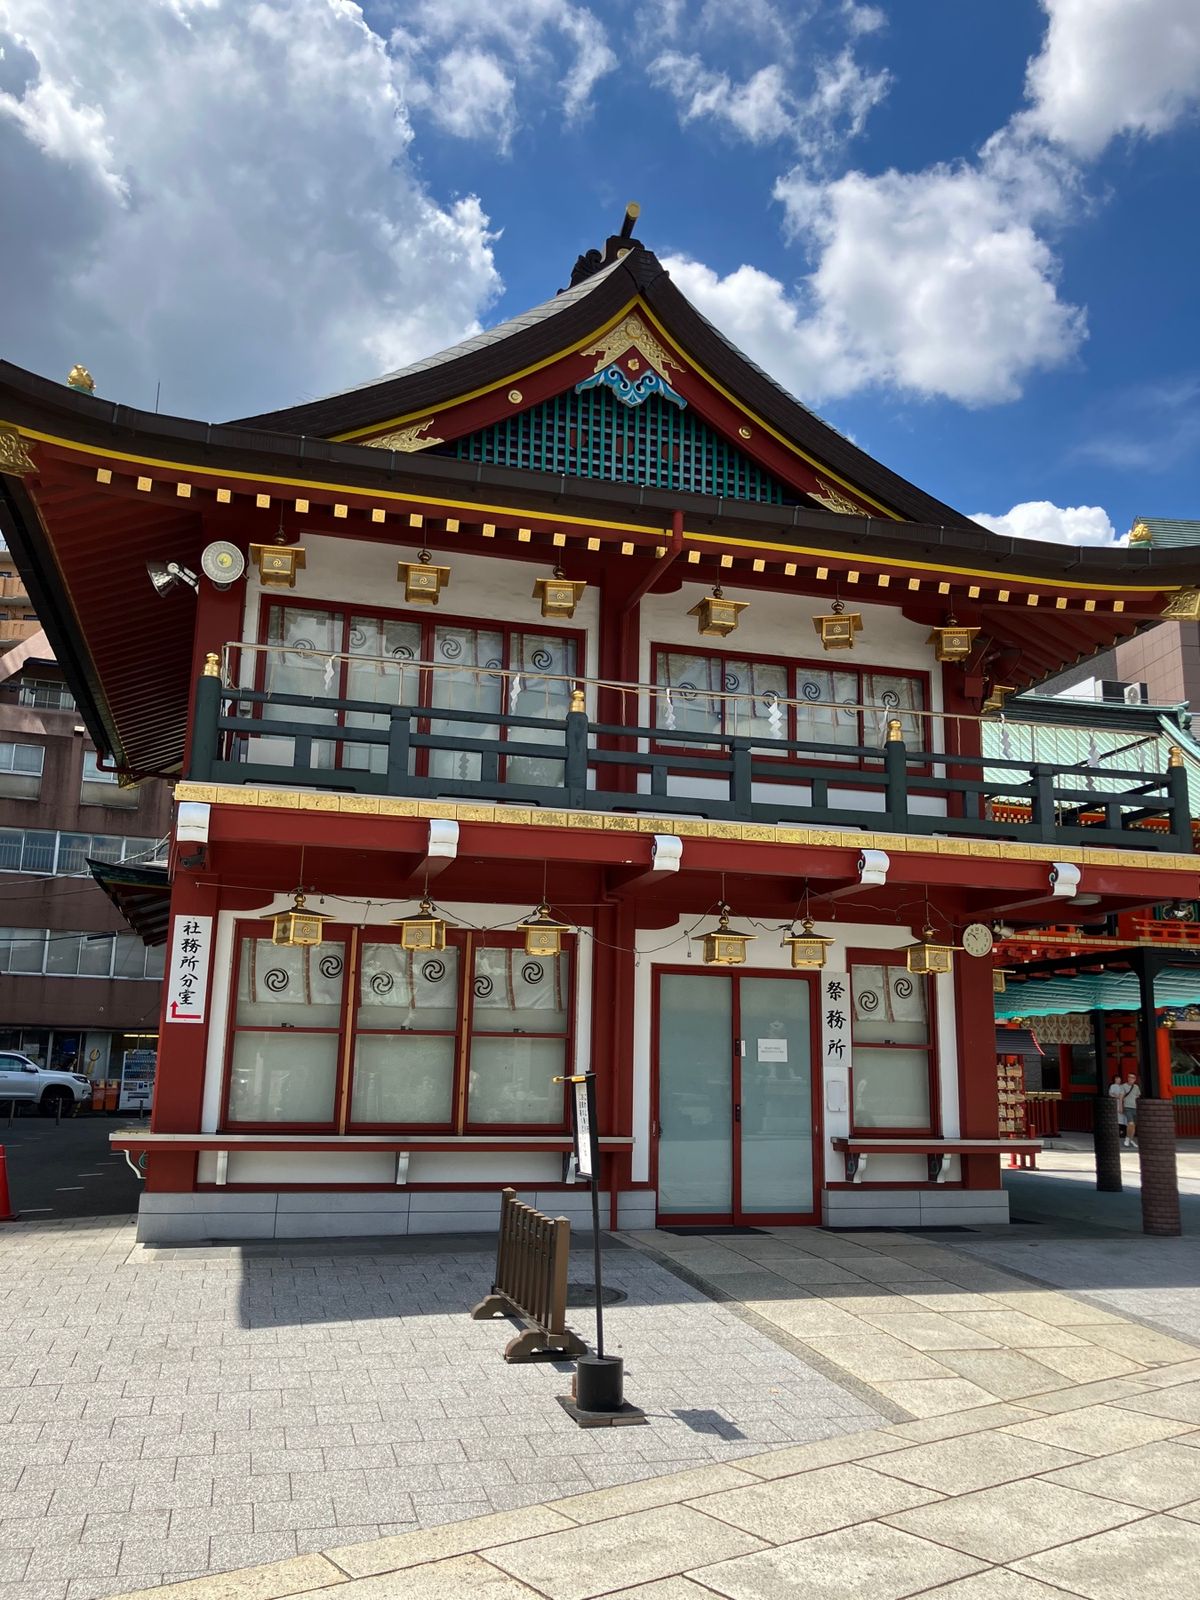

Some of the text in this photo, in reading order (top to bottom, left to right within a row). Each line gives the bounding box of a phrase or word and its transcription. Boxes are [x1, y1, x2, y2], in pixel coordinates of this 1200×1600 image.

[179, 921, 202, 1005] 社務所分室
[826, 981, 847, 1060] 祭務所
